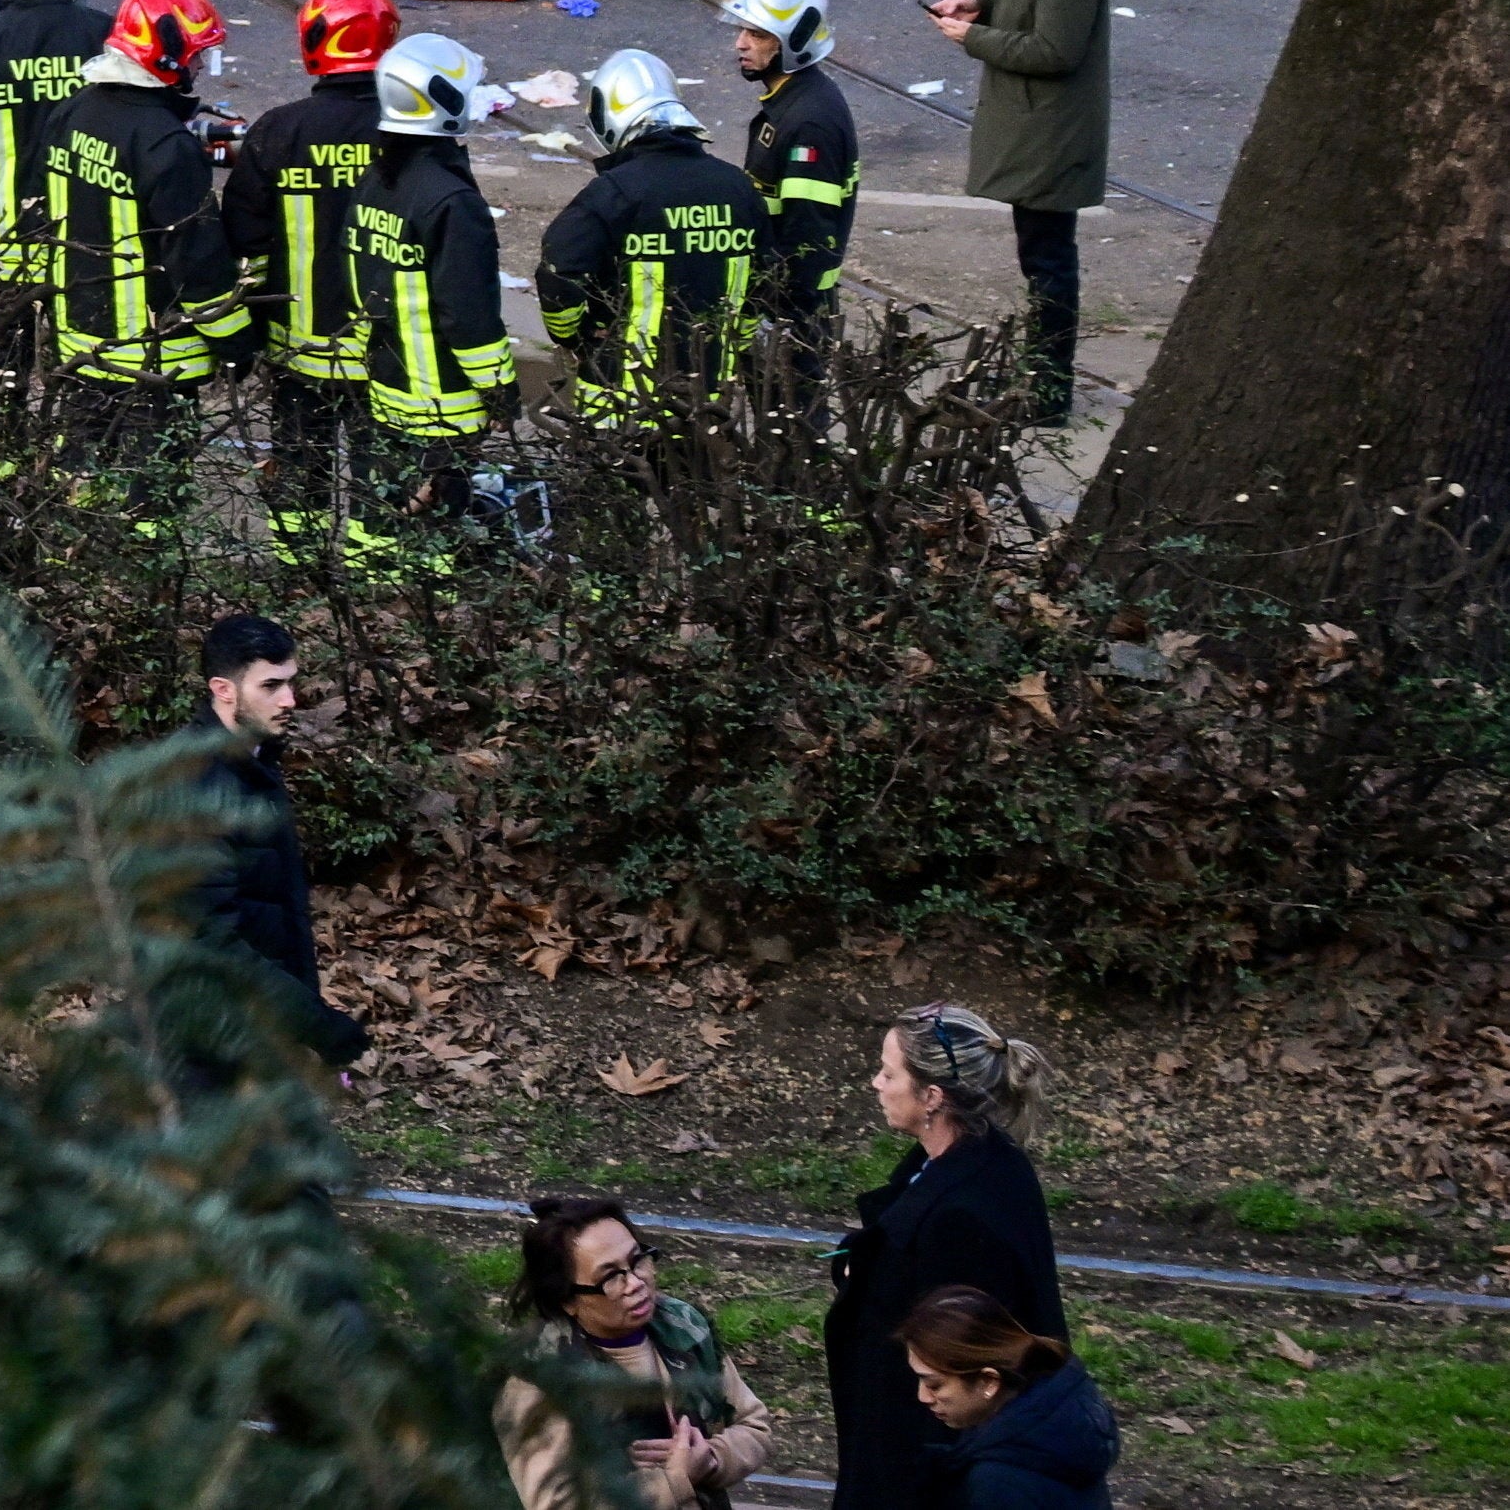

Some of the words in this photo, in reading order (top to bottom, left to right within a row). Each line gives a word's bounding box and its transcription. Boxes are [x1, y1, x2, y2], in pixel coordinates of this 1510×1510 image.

[9, 55, 81, 81] VIGILI
[33, 77, 91, 102] FUO
[71, 129, 117, 168] VIGILI
[310, 143, 383, 167] VIGIL
[356, 203, 404, 240] VIGILI
[664, 203, 732, 230] VIGILI
[624, 233, 676, 256] DEL
